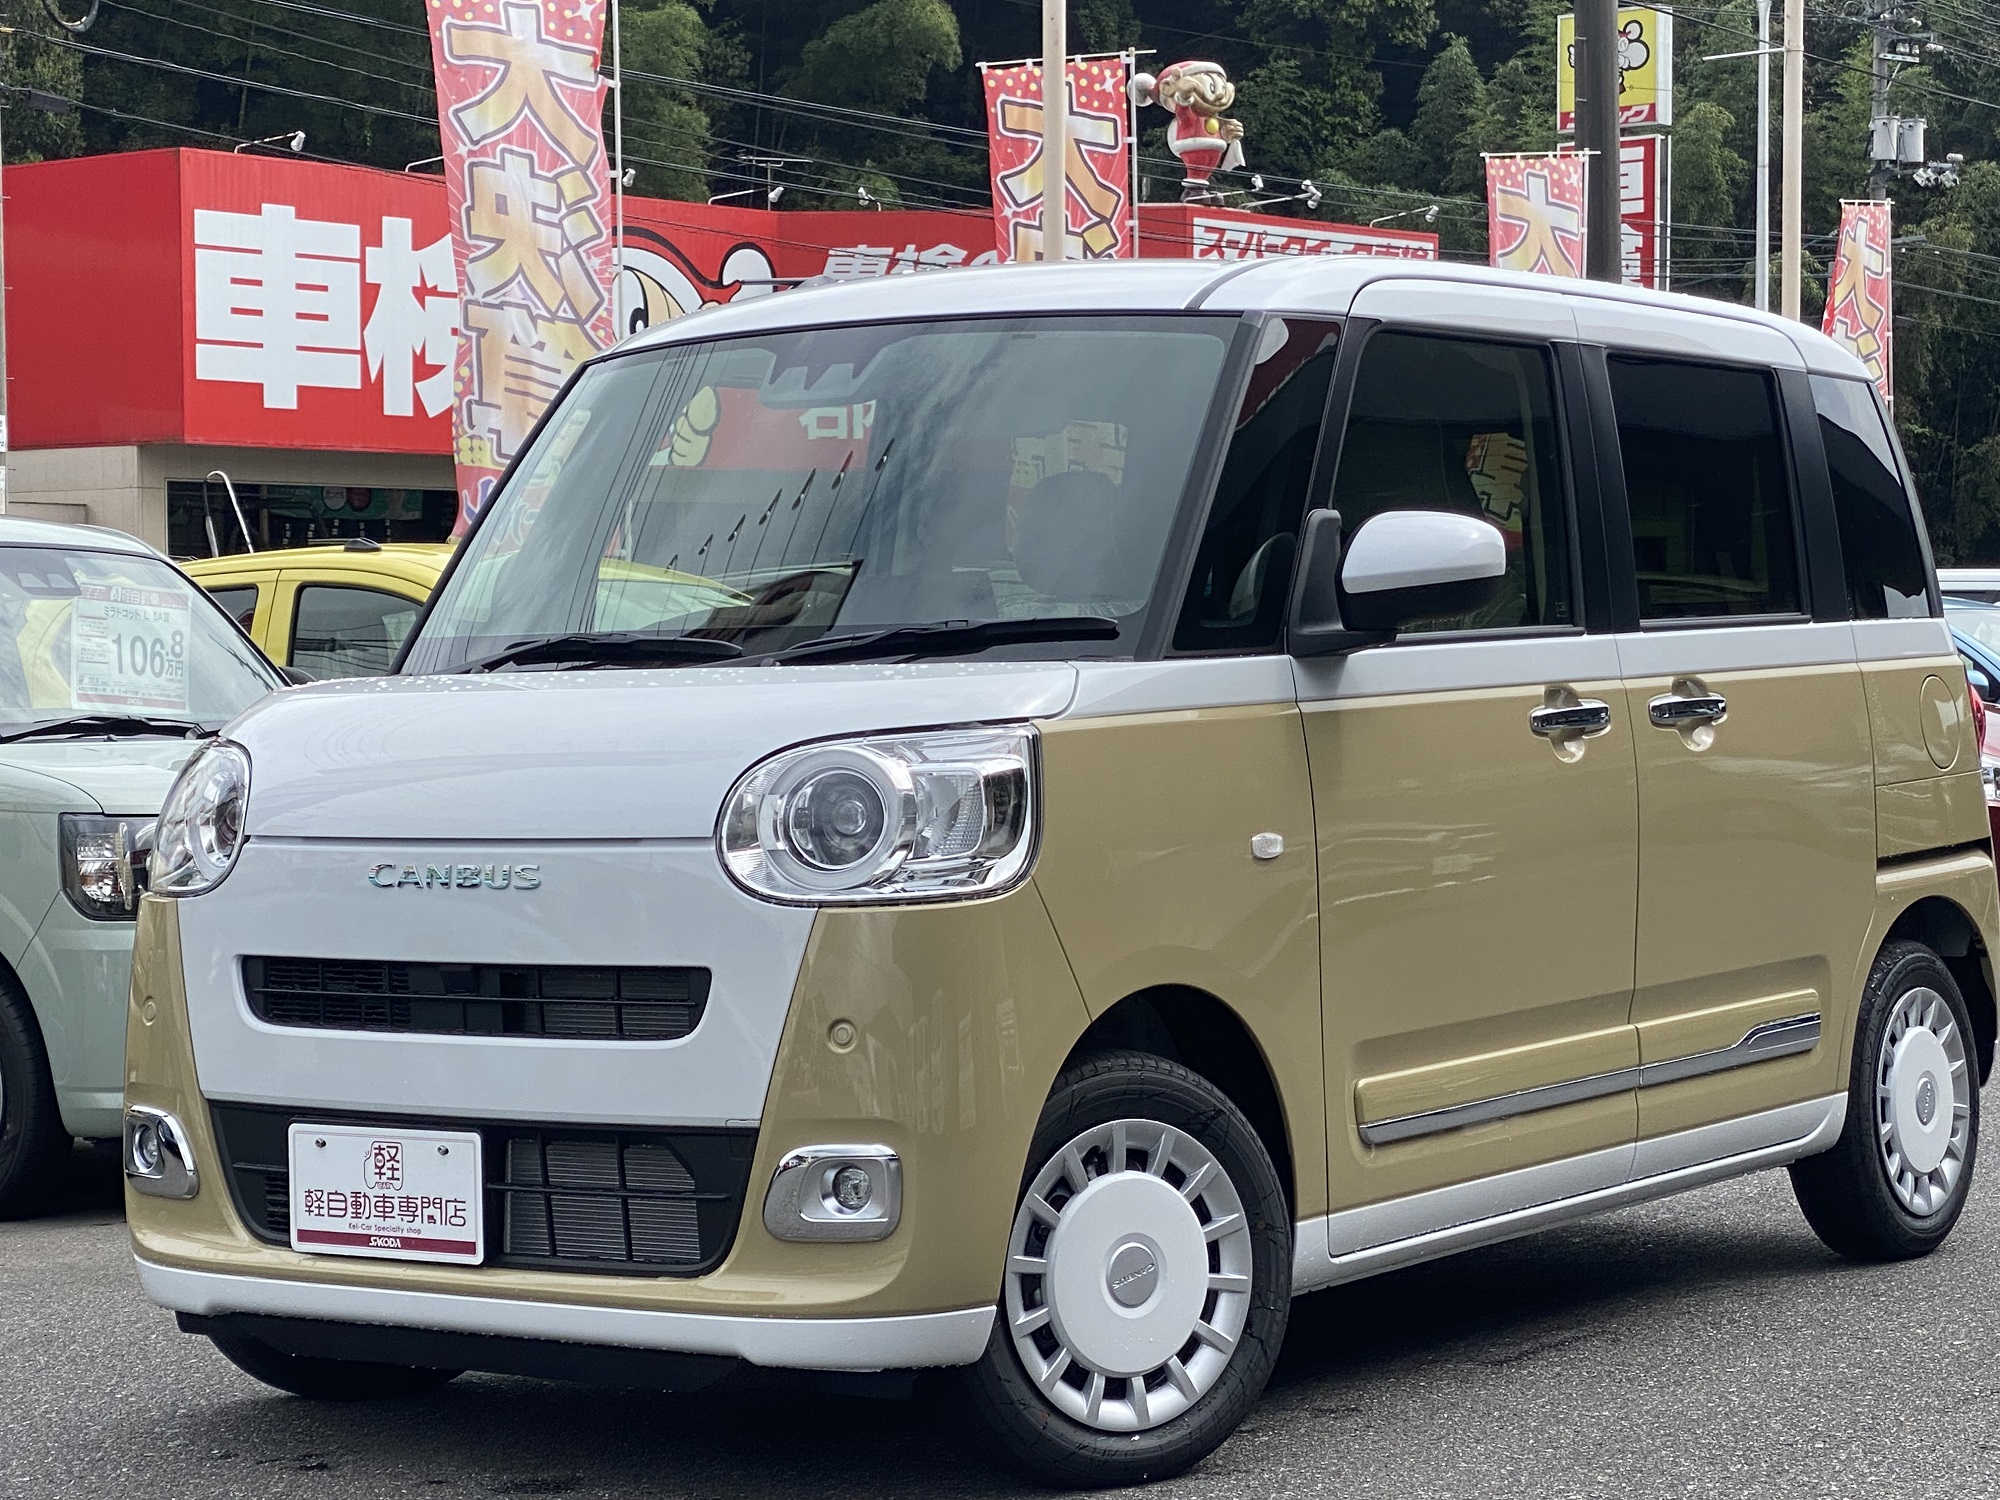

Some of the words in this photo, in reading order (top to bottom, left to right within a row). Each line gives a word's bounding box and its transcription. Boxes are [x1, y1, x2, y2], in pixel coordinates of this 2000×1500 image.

[104, 606, 140, 620] ミラトコット
[144, 611, 150, 620] L
[165, 659, 184, 677] 万円
[368, 863, 542, 890] CANBUS
[373, 1144, 400, 1181] 軽
[304, 1188, 467, 1227] 軽自動車専門店
[374, 1224, 405, 1235] Specialty
[406, 1226, 422, 1236] shop
